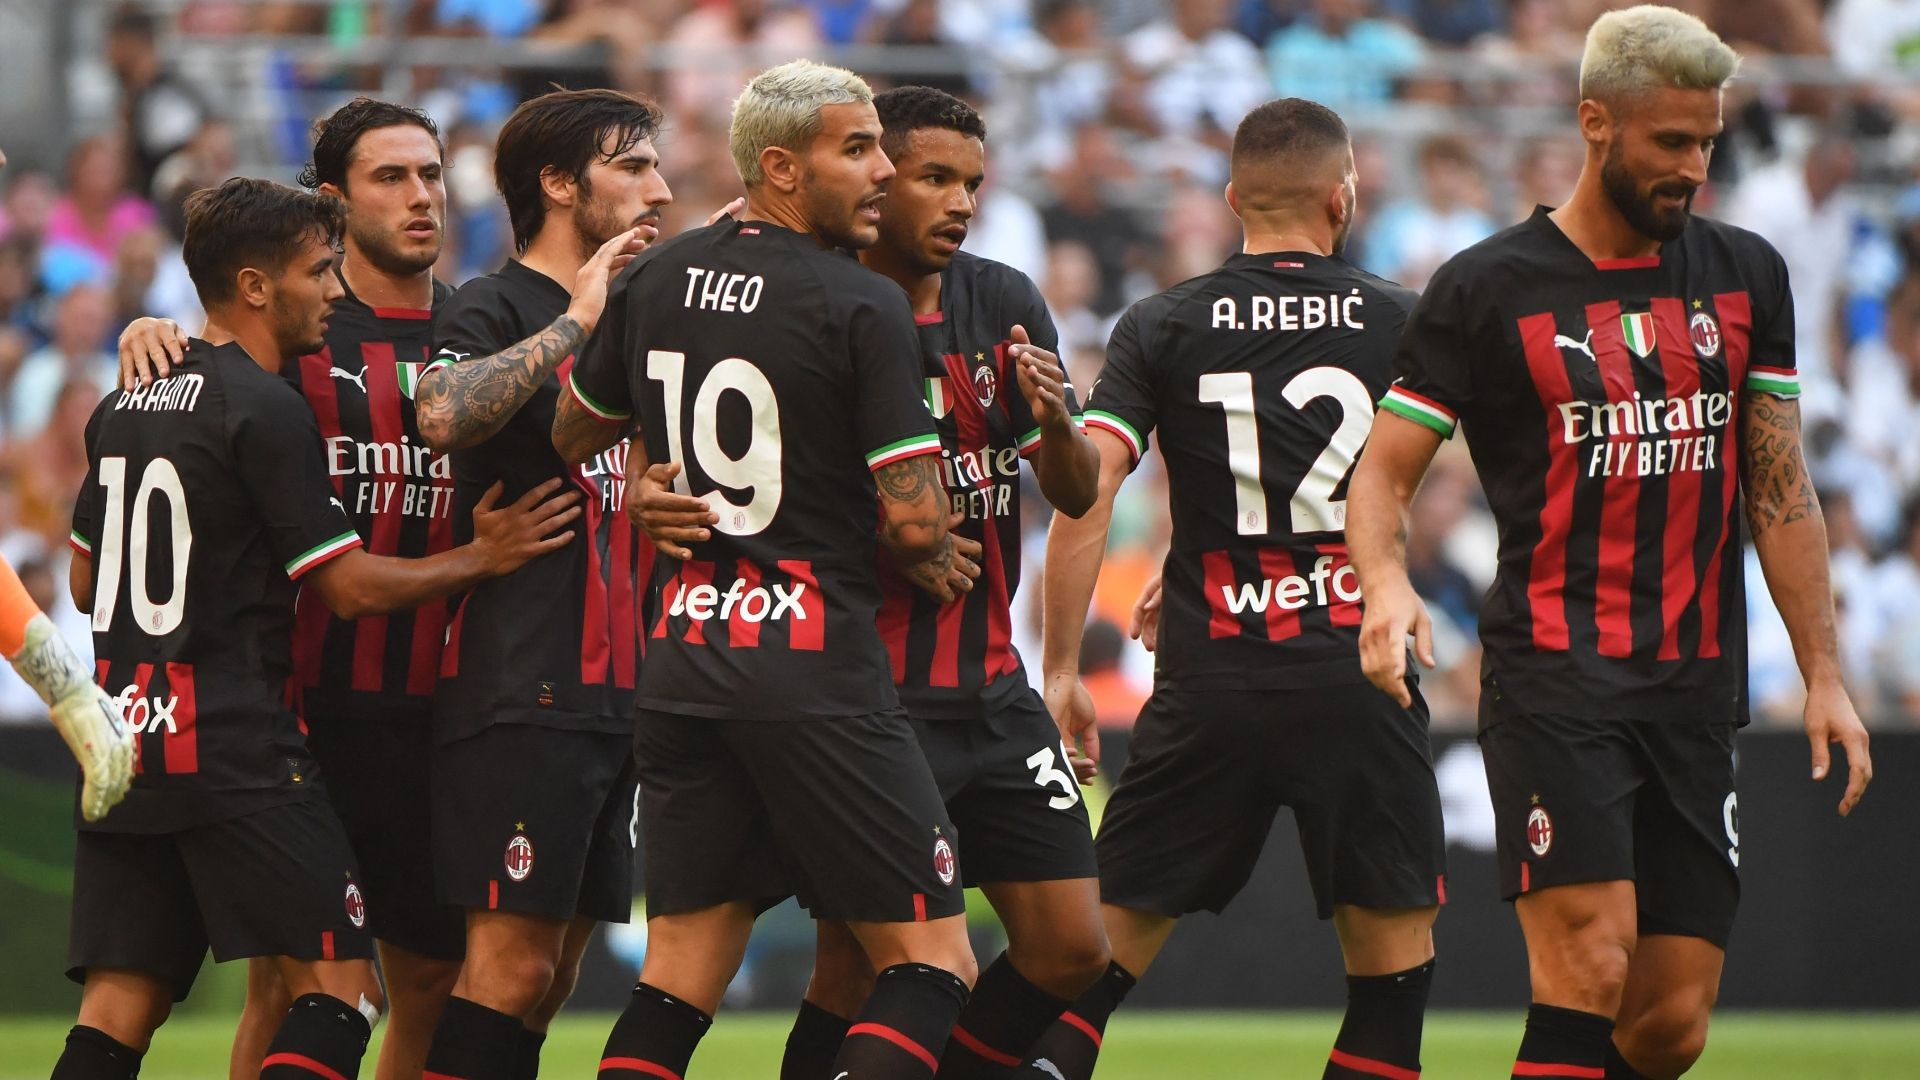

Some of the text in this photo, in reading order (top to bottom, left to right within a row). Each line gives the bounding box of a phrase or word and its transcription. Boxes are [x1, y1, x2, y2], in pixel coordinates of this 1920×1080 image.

[684, 266, 764, 314] THEO
[647, 350, 782, 536] 19
[1557, 388, 1734, 444] Emirates
[1199, 366, 1374, 535] 12
[1588, 434, 1715, 477] FLY BETTER
[355, 482, 454, 518] FLY BETT
[602, 480, 627, 512] FLY
[92, 457, 192, 636] 10
[1026, 739, 1082, 810] 3
